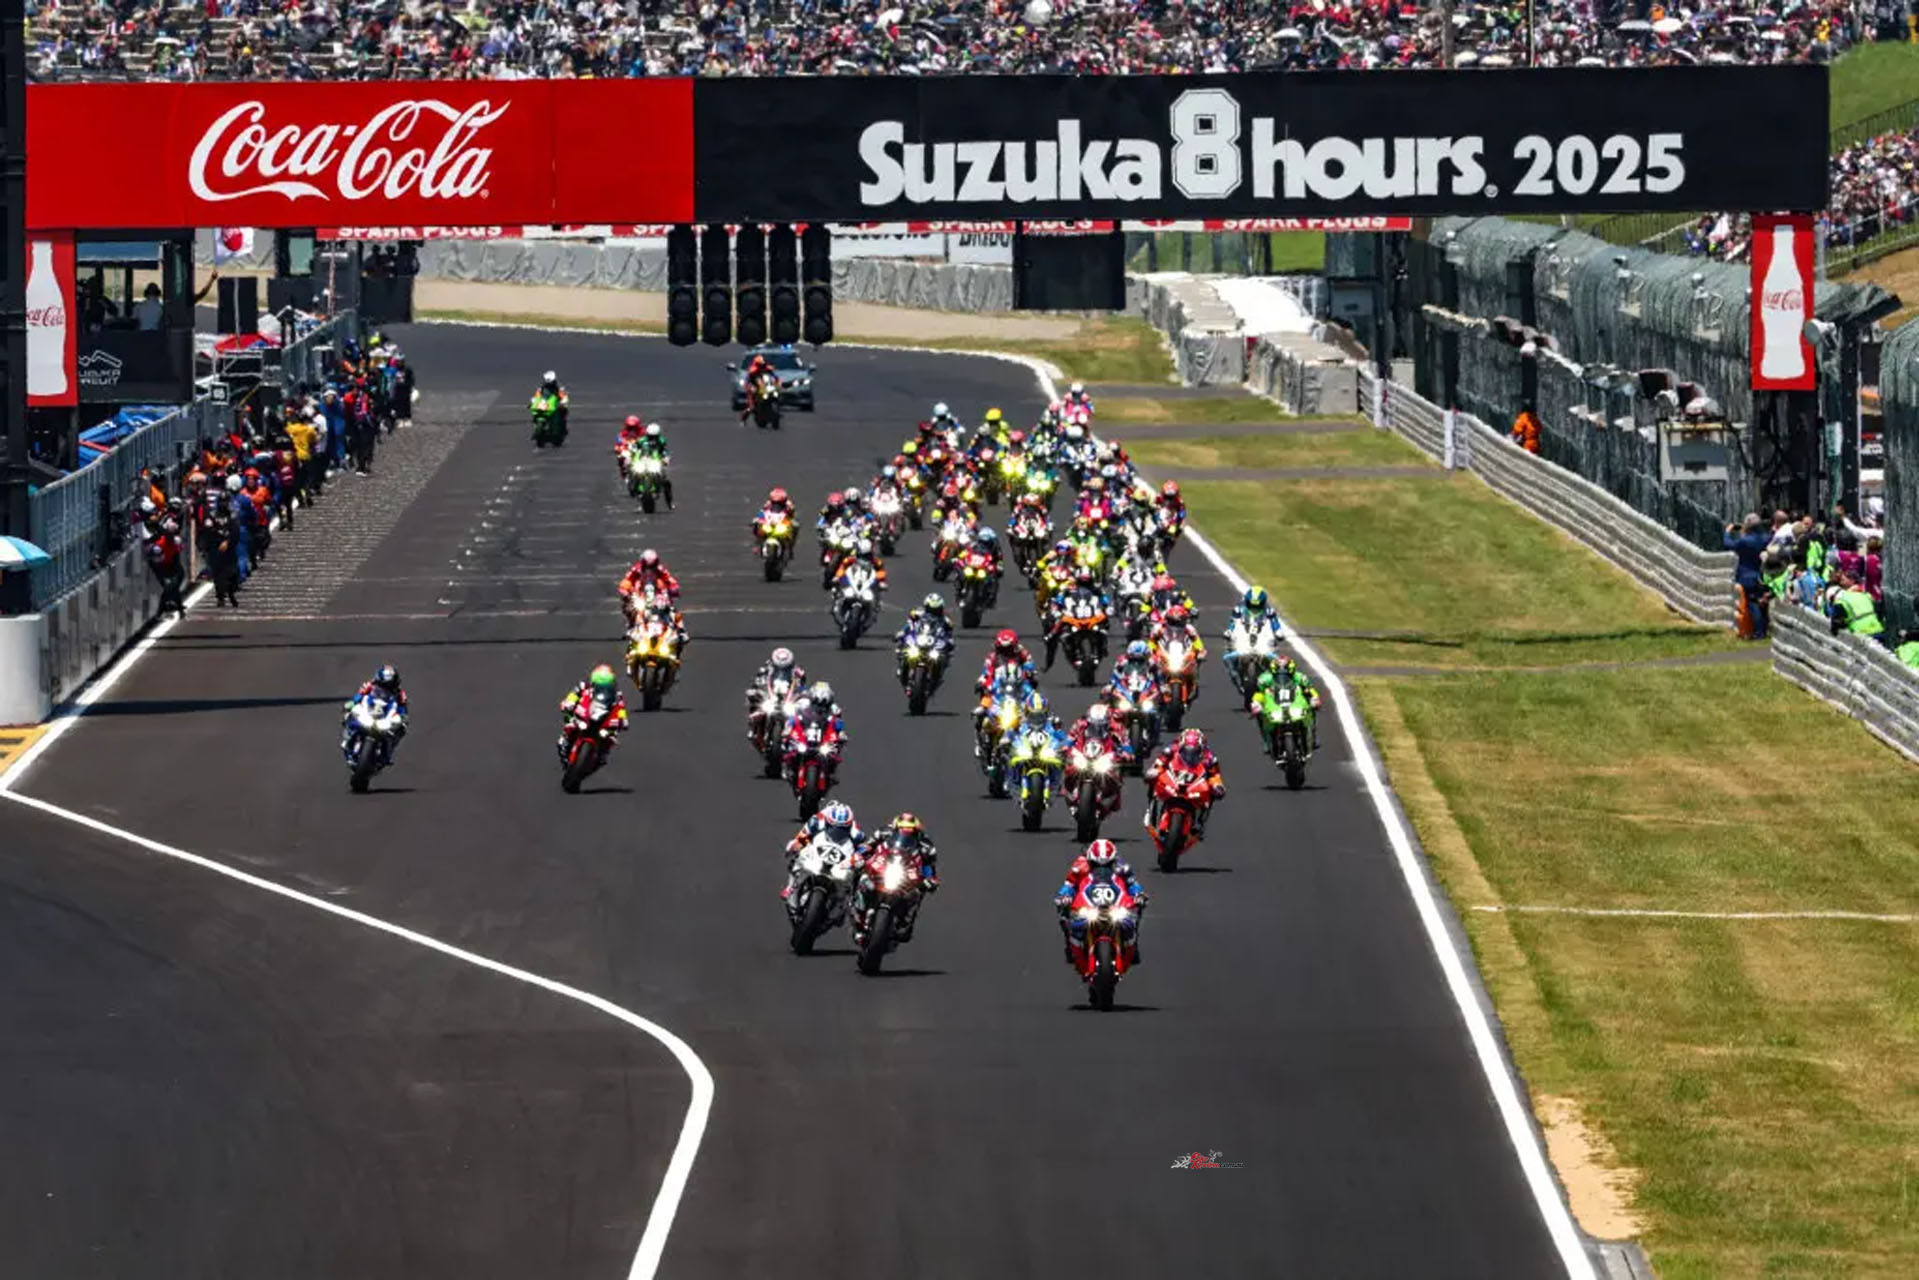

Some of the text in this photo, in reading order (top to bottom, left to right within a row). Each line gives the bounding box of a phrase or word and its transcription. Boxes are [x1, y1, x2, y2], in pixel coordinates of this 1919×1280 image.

[189, 100, 509, 202] Coca-Cola
[859, 119, 1161, 205] Suzuka
[1170, 88, 1242, 200] 8
[1514, 134, 1686, 196] 2025
[1091, 887, 1116, 907] 30
